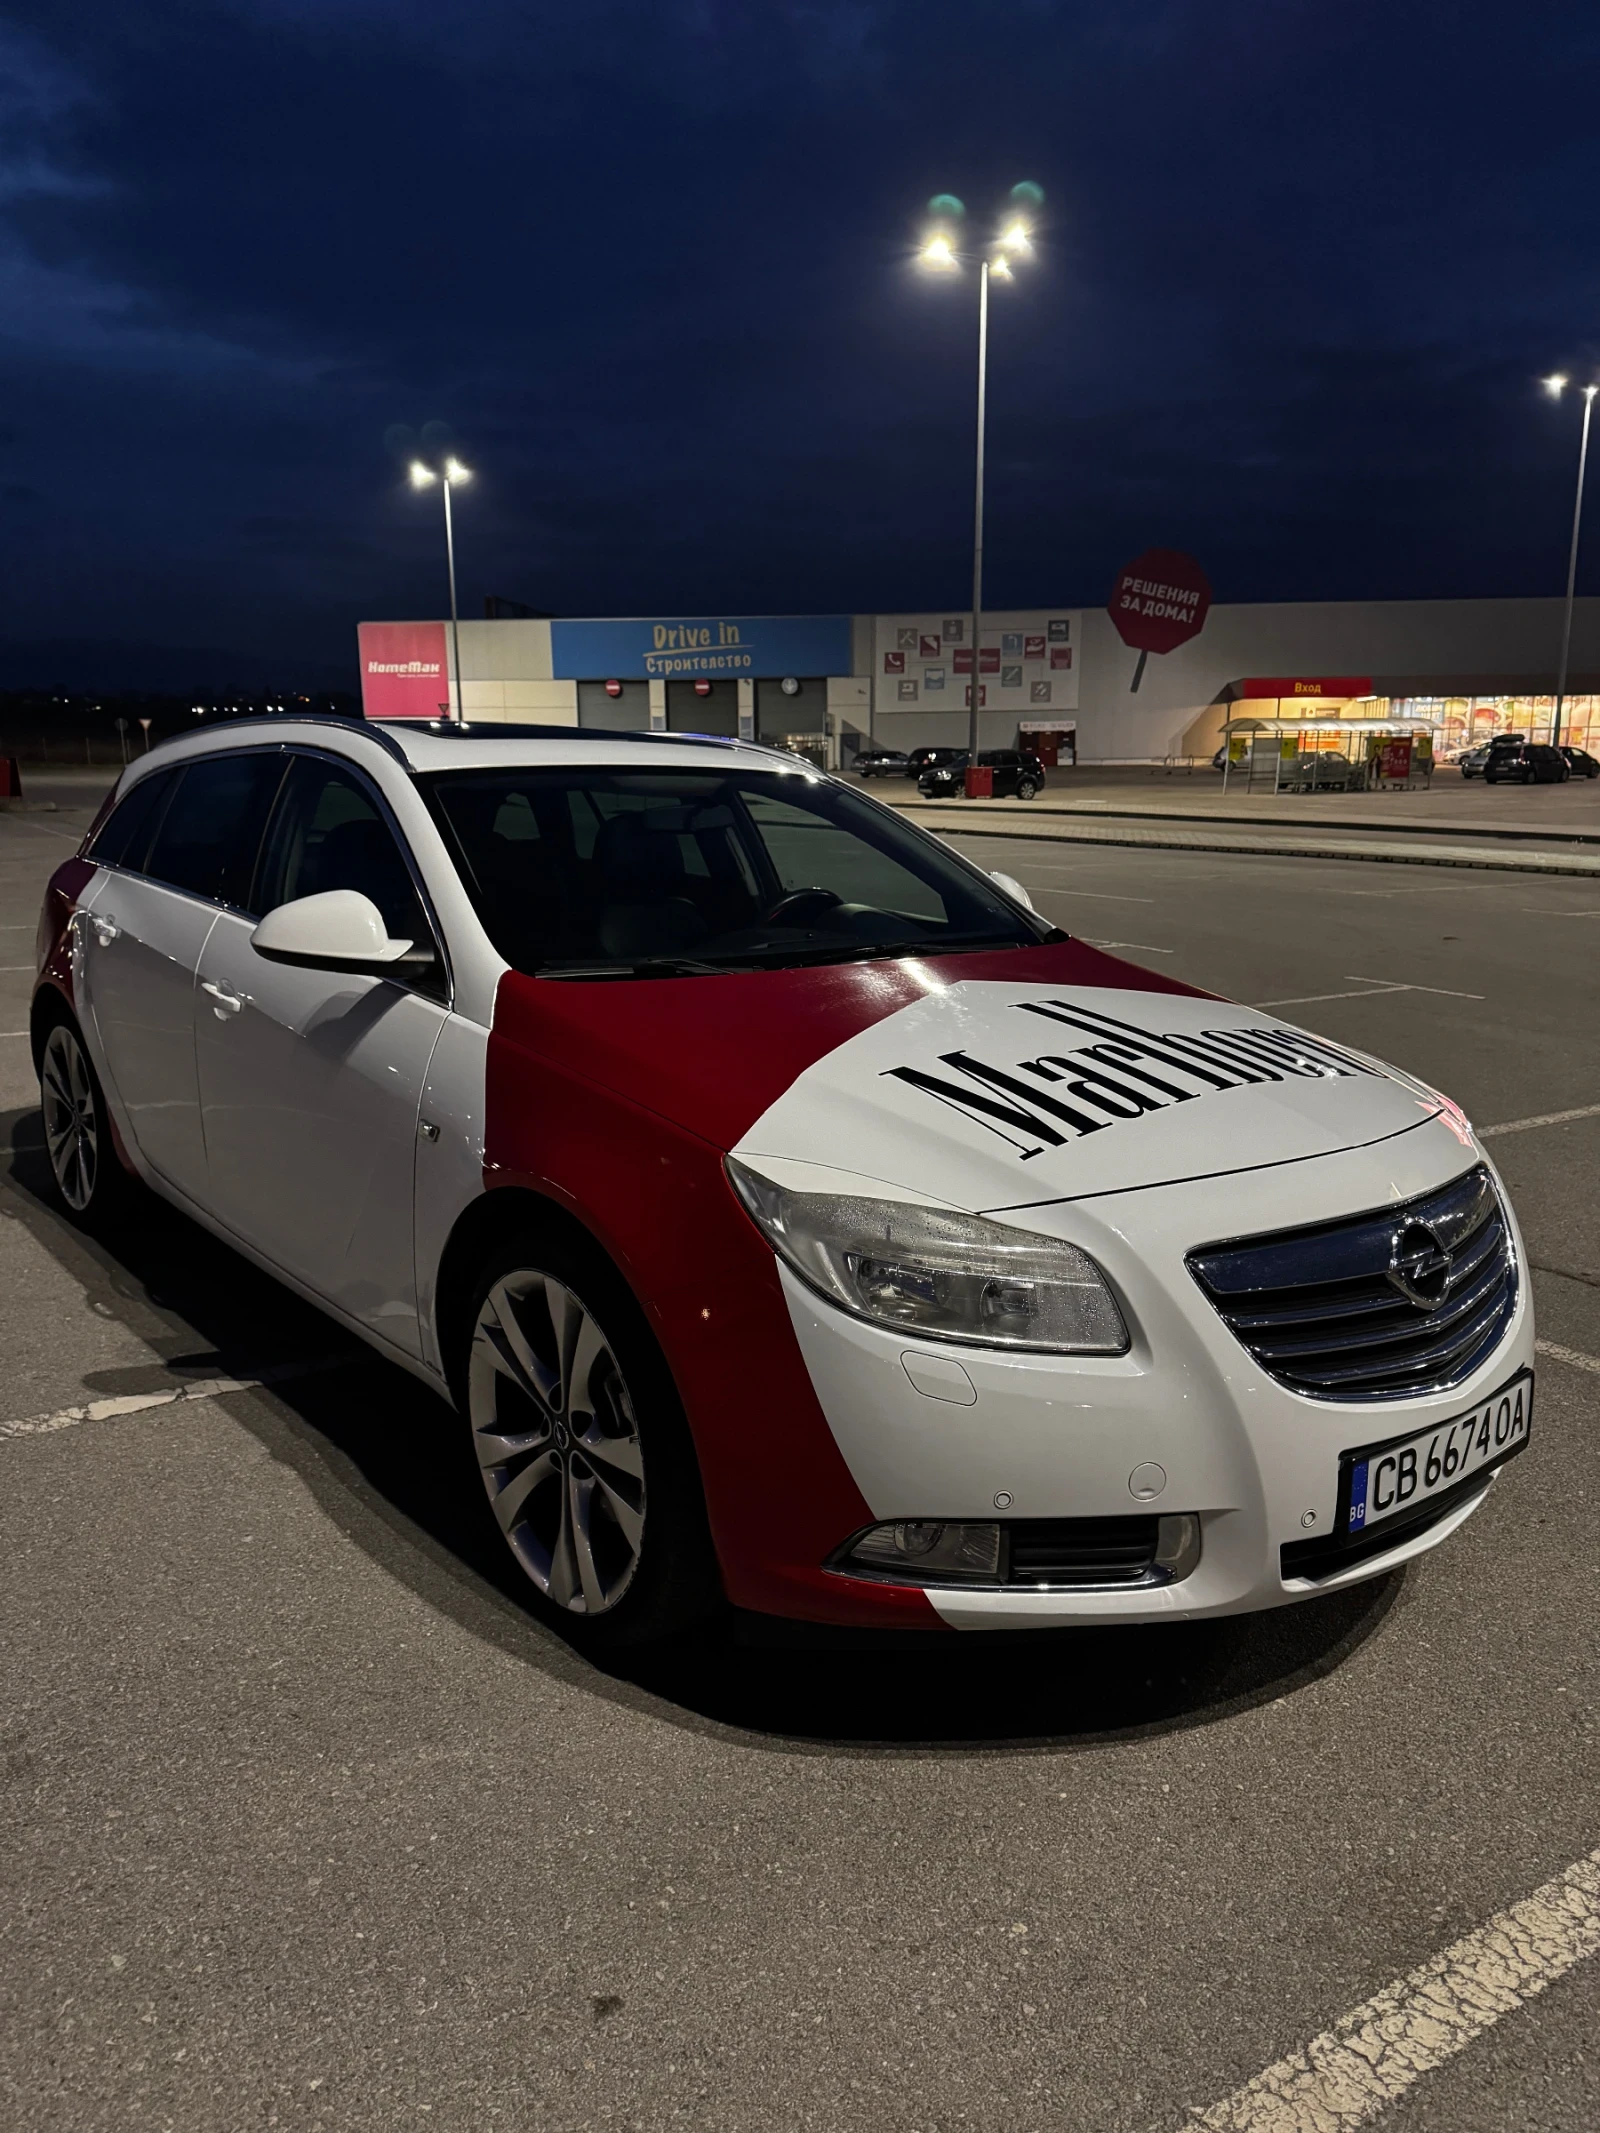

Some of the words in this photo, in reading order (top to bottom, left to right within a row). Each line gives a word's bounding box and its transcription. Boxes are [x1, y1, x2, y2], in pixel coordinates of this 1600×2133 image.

[1121, 576, 1200, 606] РЕШЕНИЯ
[1120, 595, 1142, 612] ЗА
[1142, 601, 1195, 624] ДОМА!
[653, 623, 710, 649] Drive
[719, 622, 740, 645] in
[646, 655, 751, 675] Строителство
[1294, 682, 1321, 694] Вход
[1349, 1502, 1365, 1523] BG
